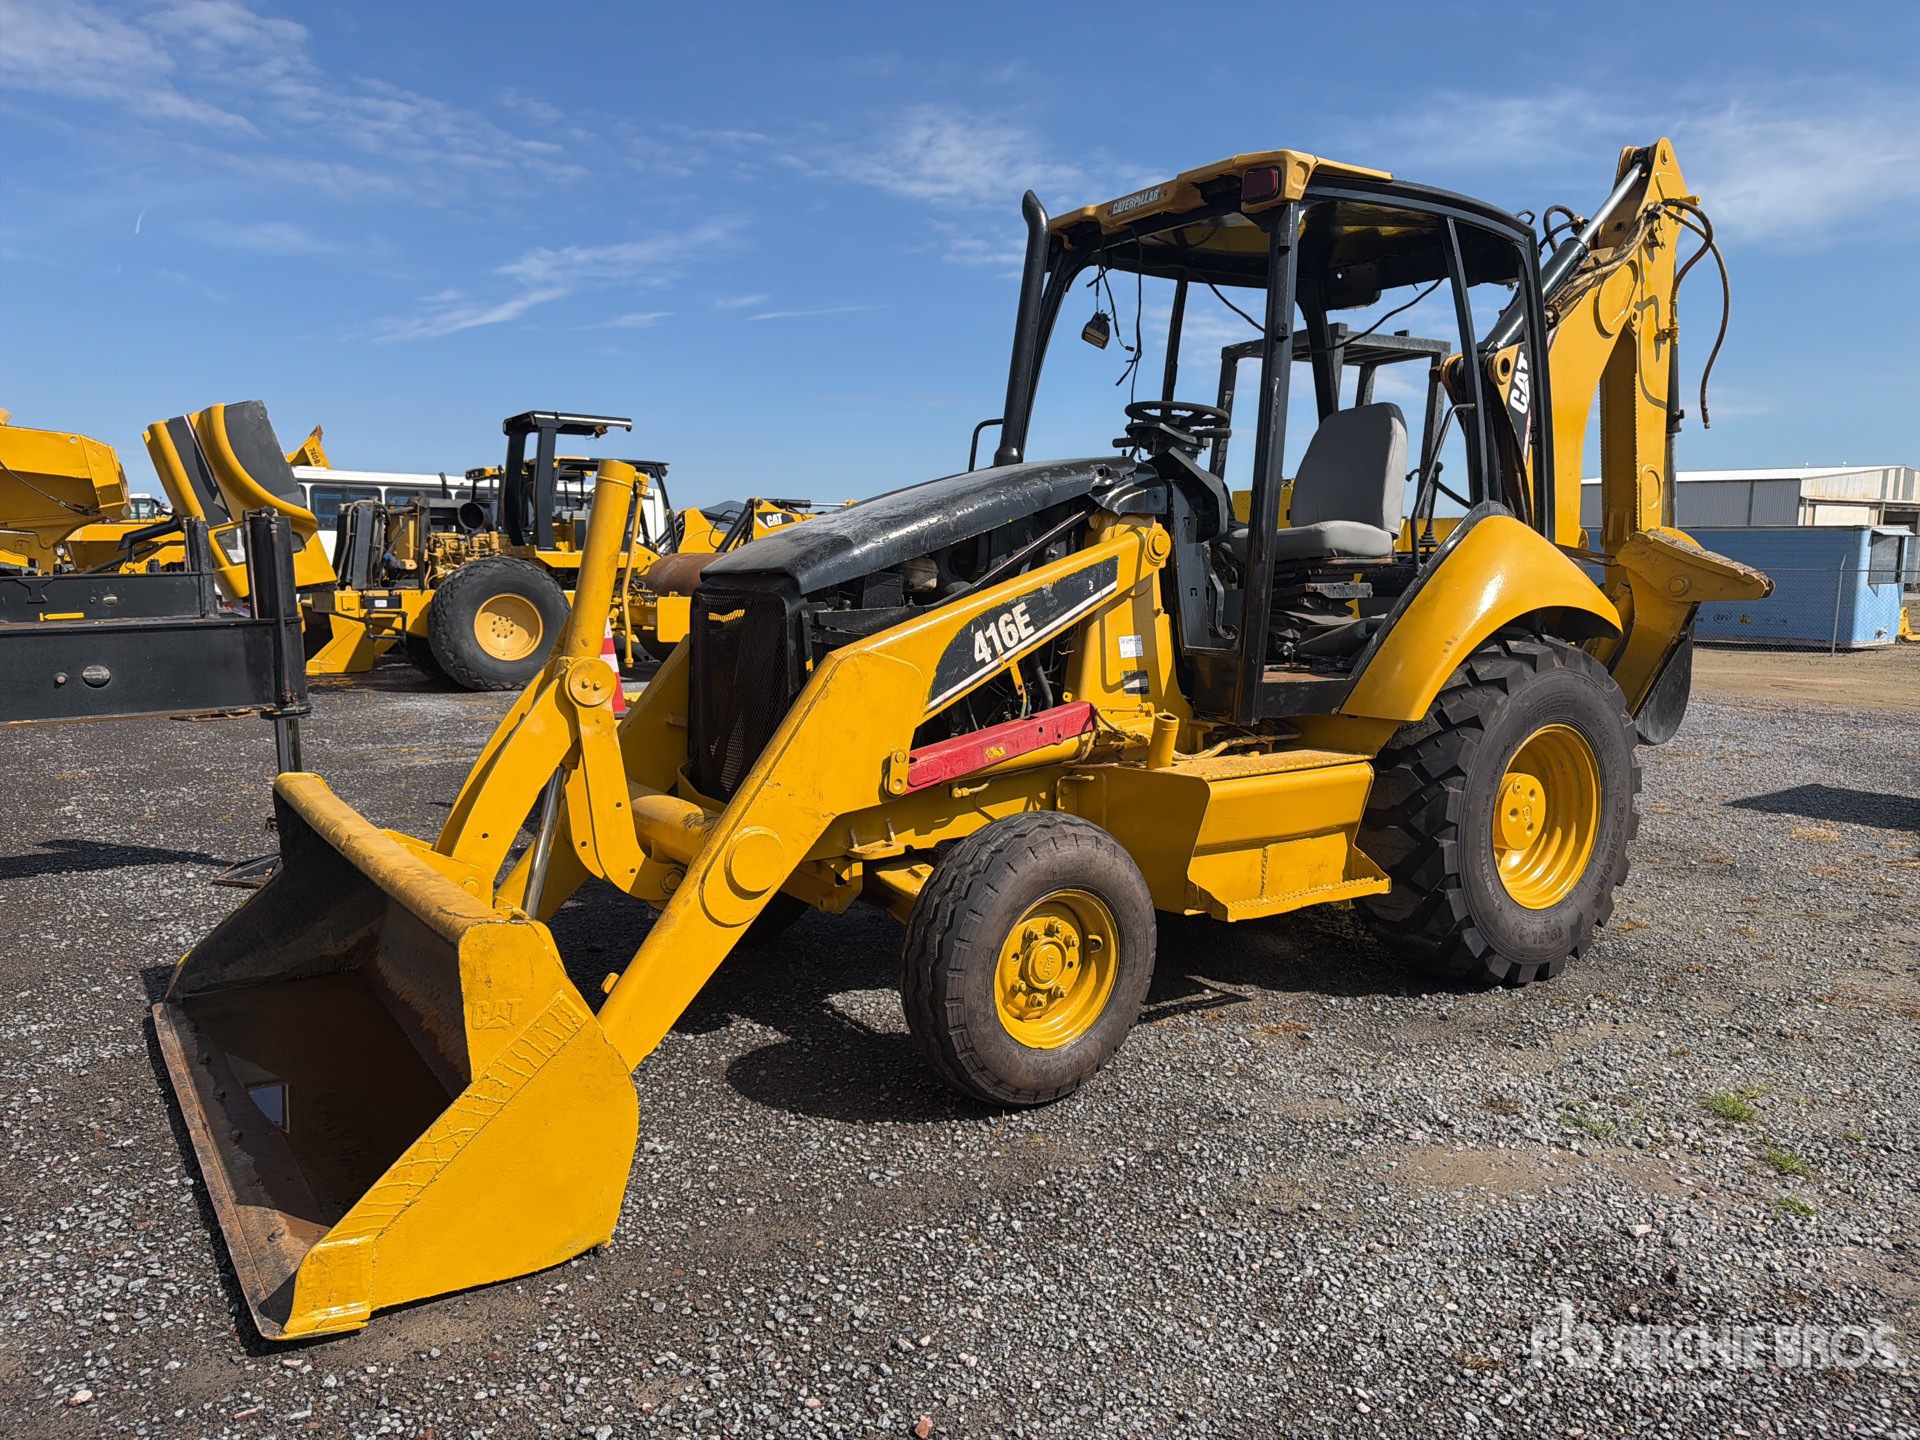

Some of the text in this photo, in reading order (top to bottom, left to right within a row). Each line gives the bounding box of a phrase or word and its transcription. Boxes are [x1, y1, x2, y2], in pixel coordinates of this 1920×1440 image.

[1112, 189, 1159, 215] CATERPILLAR
[1510, 351, 1530, 414] CAT
[308, 447, 321, 465] 740B
[766, 513, 783, 527] CAT
[973, 601, 1035, 663] 416E
[471, 999, 524, 1030] CAT
